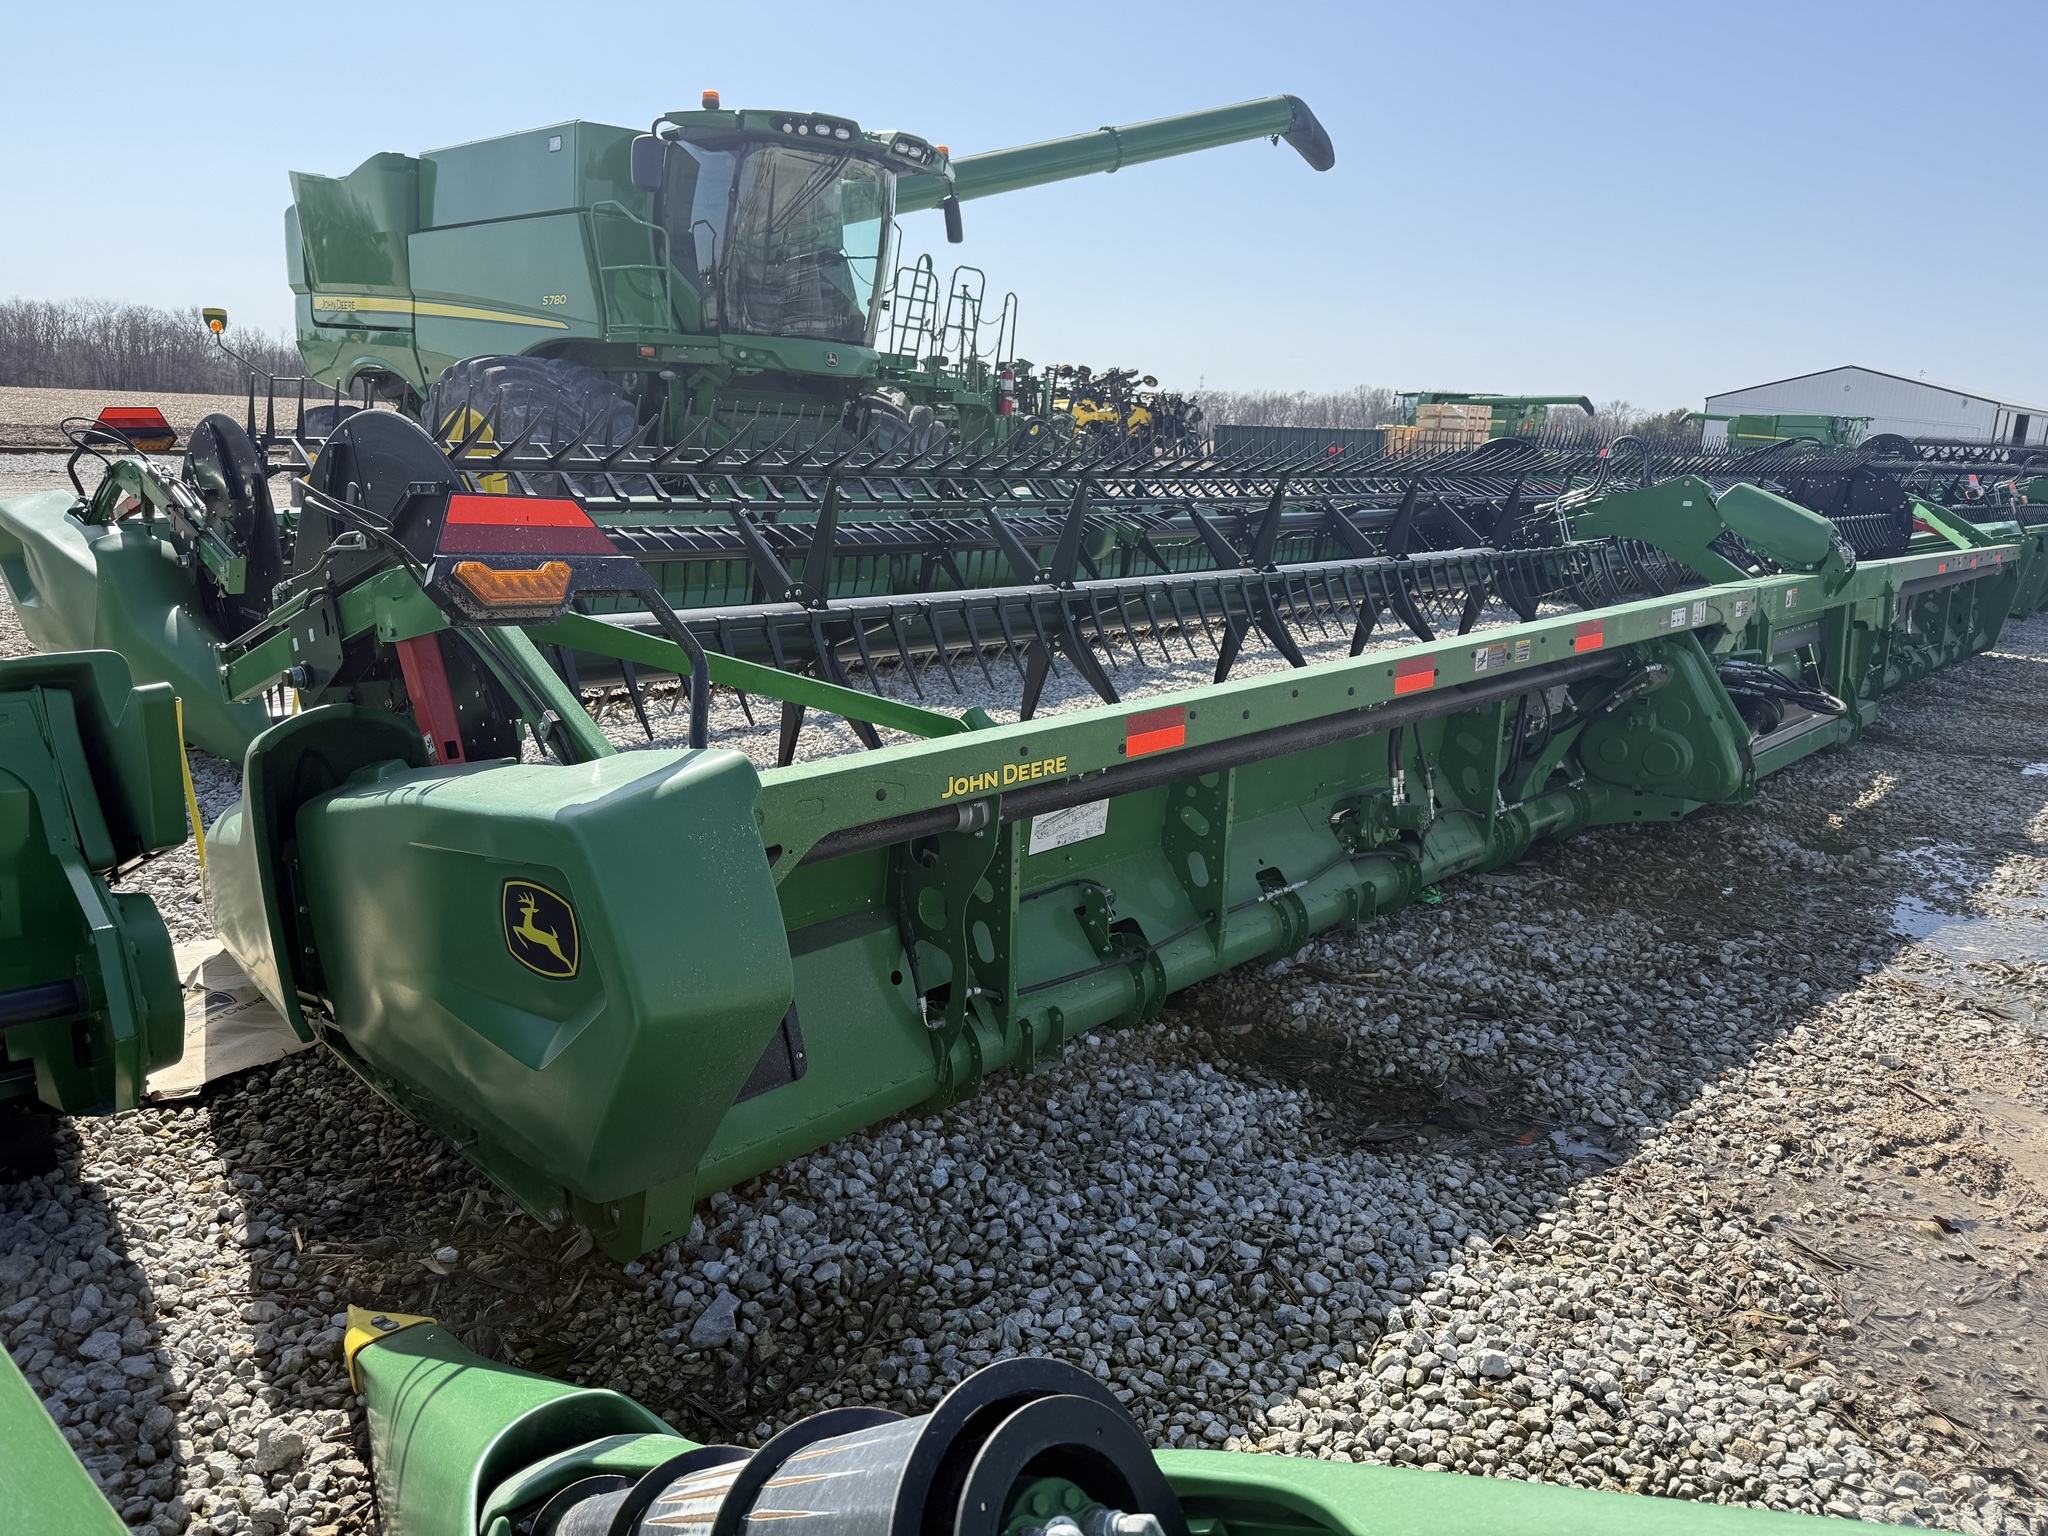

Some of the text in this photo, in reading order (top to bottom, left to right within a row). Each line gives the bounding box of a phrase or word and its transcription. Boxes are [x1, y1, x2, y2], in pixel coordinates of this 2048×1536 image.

[321, 299, 356, 310] JOHN DEERE
[542, 294, 567, 306] S780
[941, 755, 1067, 799] JOHN DEERE
